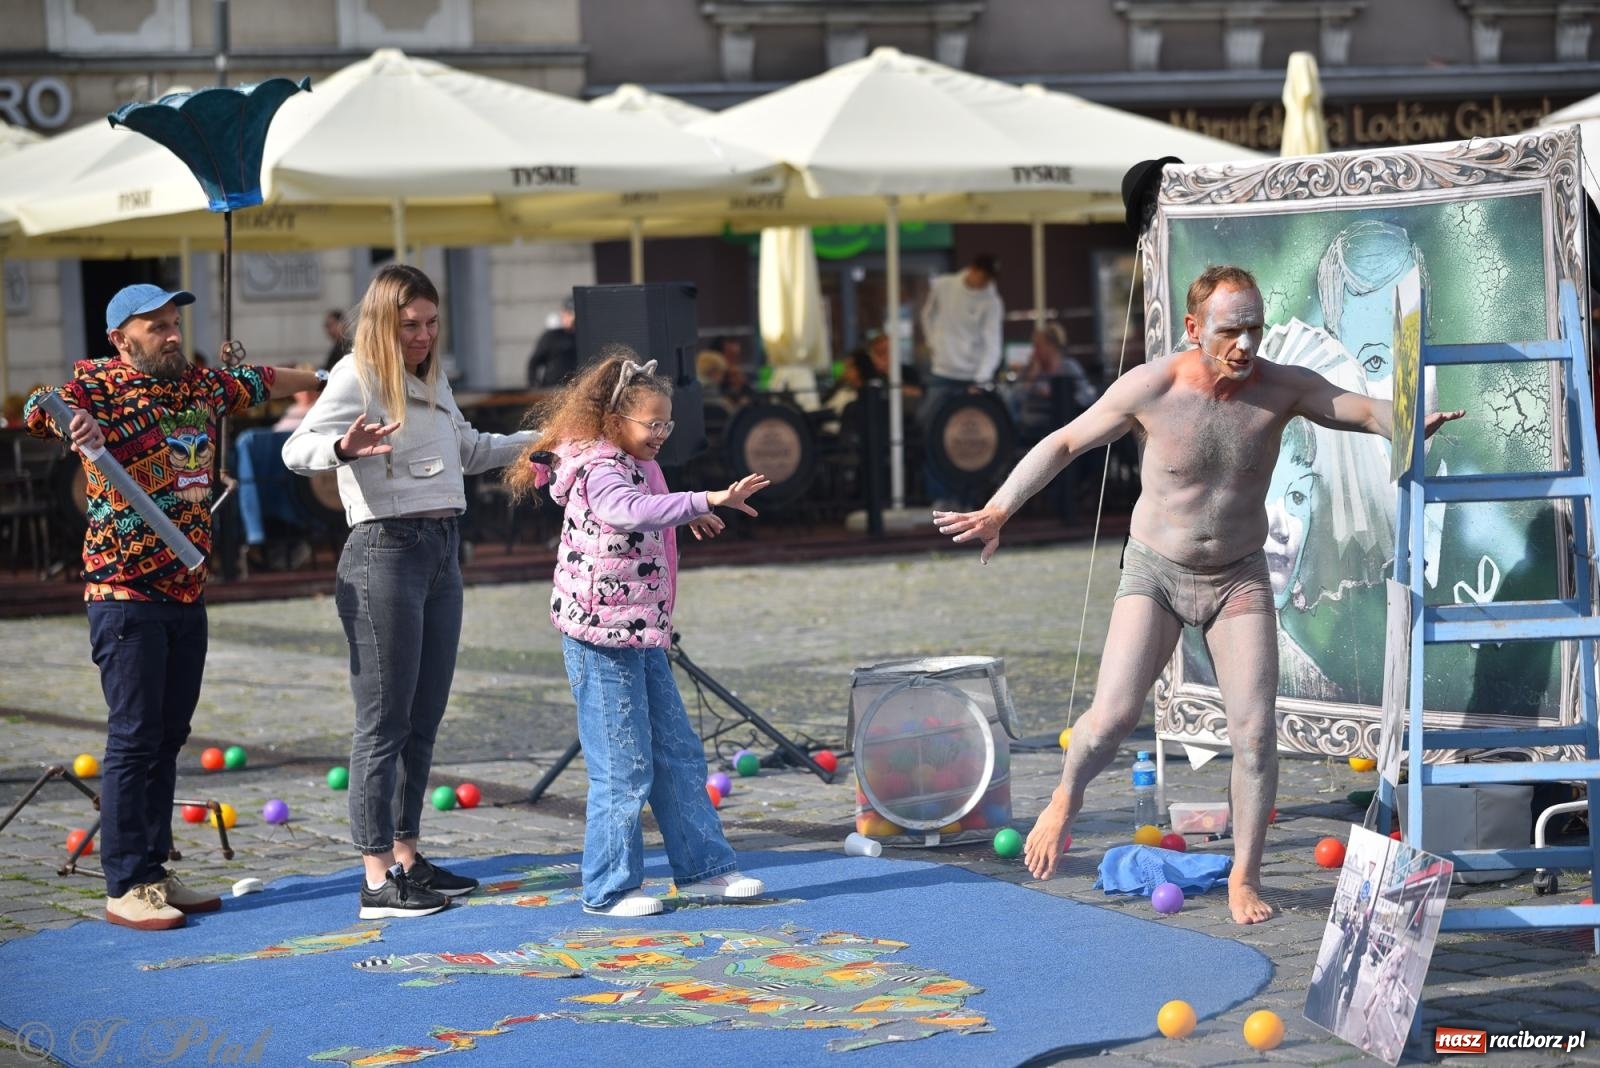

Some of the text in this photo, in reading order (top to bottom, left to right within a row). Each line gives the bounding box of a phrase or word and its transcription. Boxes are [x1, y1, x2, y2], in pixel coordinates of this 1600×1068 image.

[1353, 102, 1448, 144] Lodów
[509, 165, 580, 187] TYSKIE
[1010, 165, 1074, 185] TYSKIE
